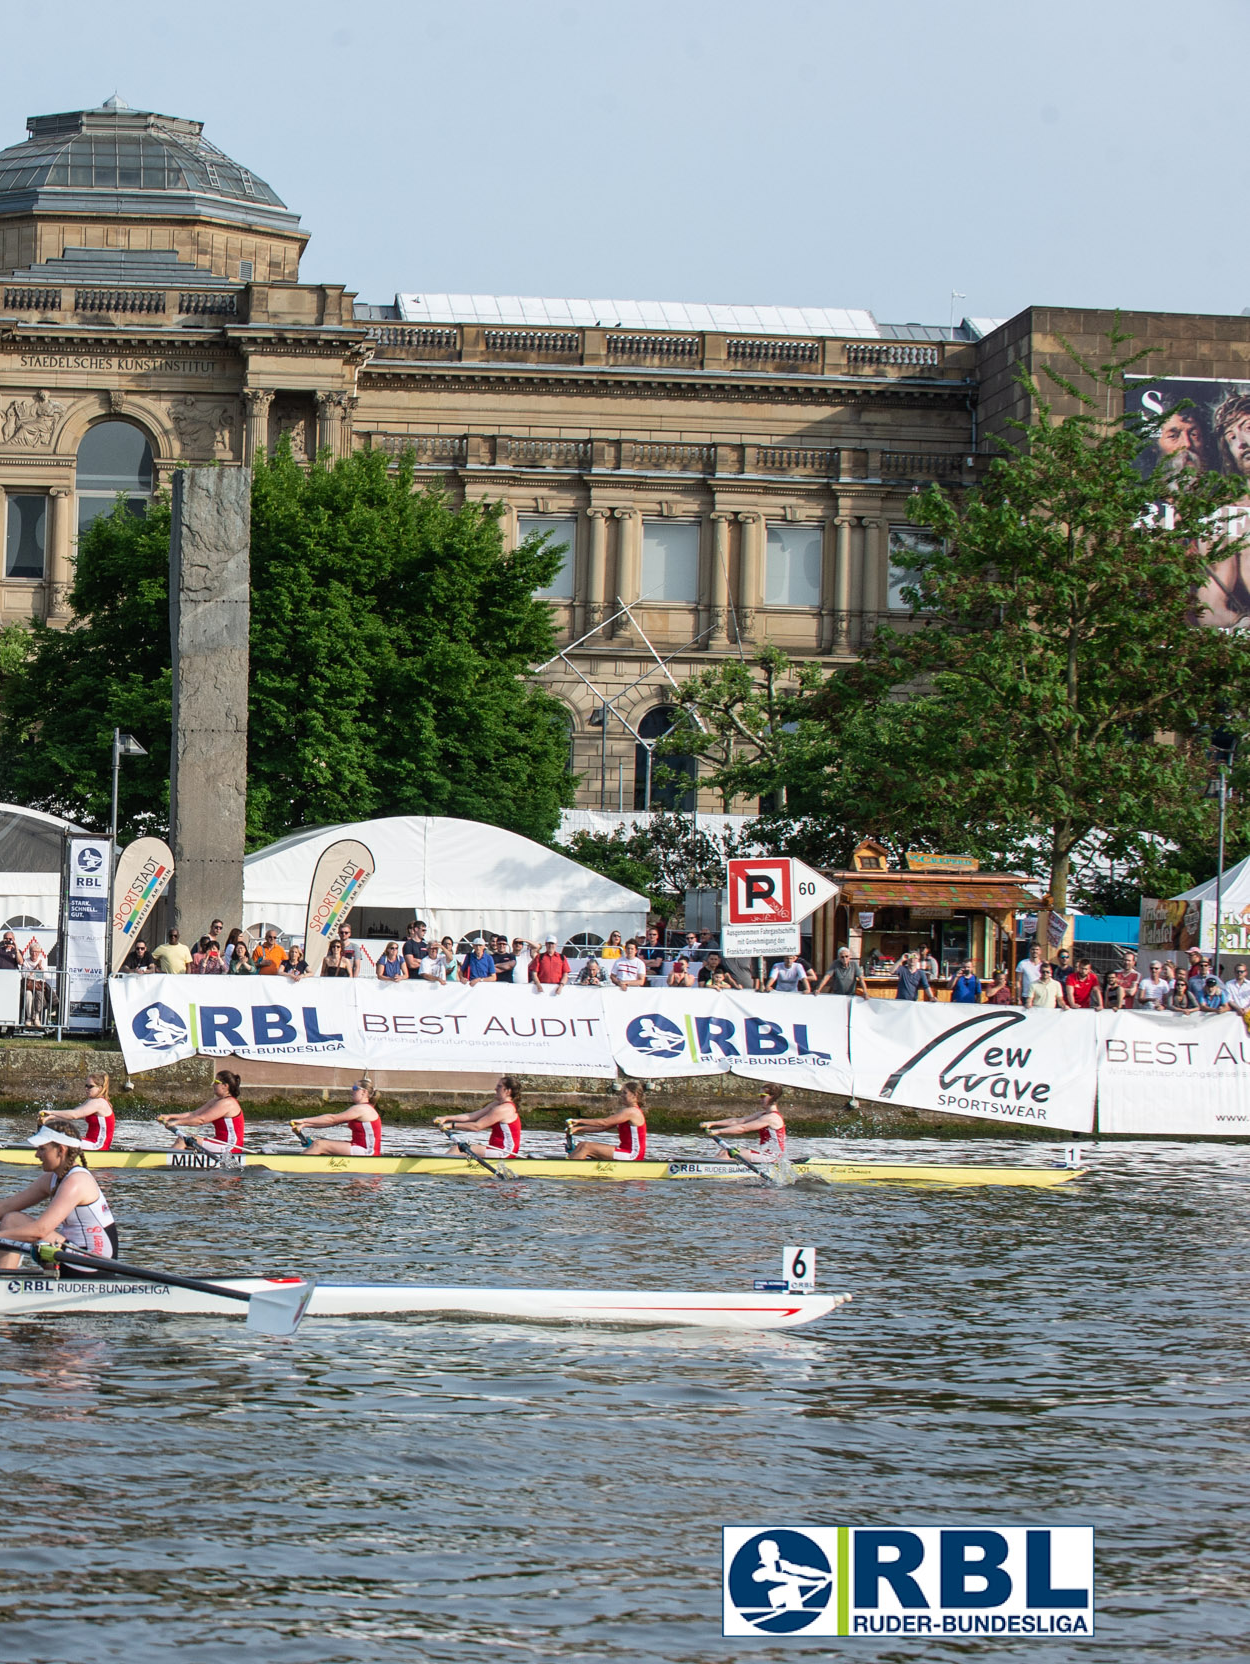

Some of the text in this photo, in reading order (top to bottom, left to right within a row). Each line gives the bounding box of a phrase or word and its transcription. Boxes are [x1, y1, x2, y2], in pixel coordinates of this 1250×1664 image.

[20, 355, 217, 373] STAEDELSCHES KUNSTINSTITUT
[76, 877, 102, 887] RBL
[112, 856, 160, 930] SPORTSTADT
[310, 858, 358, 932] SPORTSTADT
[746, 875, 776, 908] P
[798, 882, 816, 896] 60
[130, 869, 172, 938] FRANKFURT AM MAIN
[327, 872, 370, 940] FRANKFURT AM MAIN
[1143, 922, 1172, 944] Falafel
[1212, 927, 1250, 949] Fal
[200, 1004, 344, 1048] RBL
[362, 1014, 600, 1038] BEST AUDIT
[694, 1016, 832, 1060] RBL
[1106, 1039, 1199, 1065] BEST
[938, 1094, 1048, 1120] SPORTSWEAR
[682, 1164, 702, 1172] RBL
[1068, 1148, 1076, 1162] 1
[792, 1248, 806, 1278] 6
[24, 1280, 170, 1295] RBL RUDER-BUNDESLIGA
